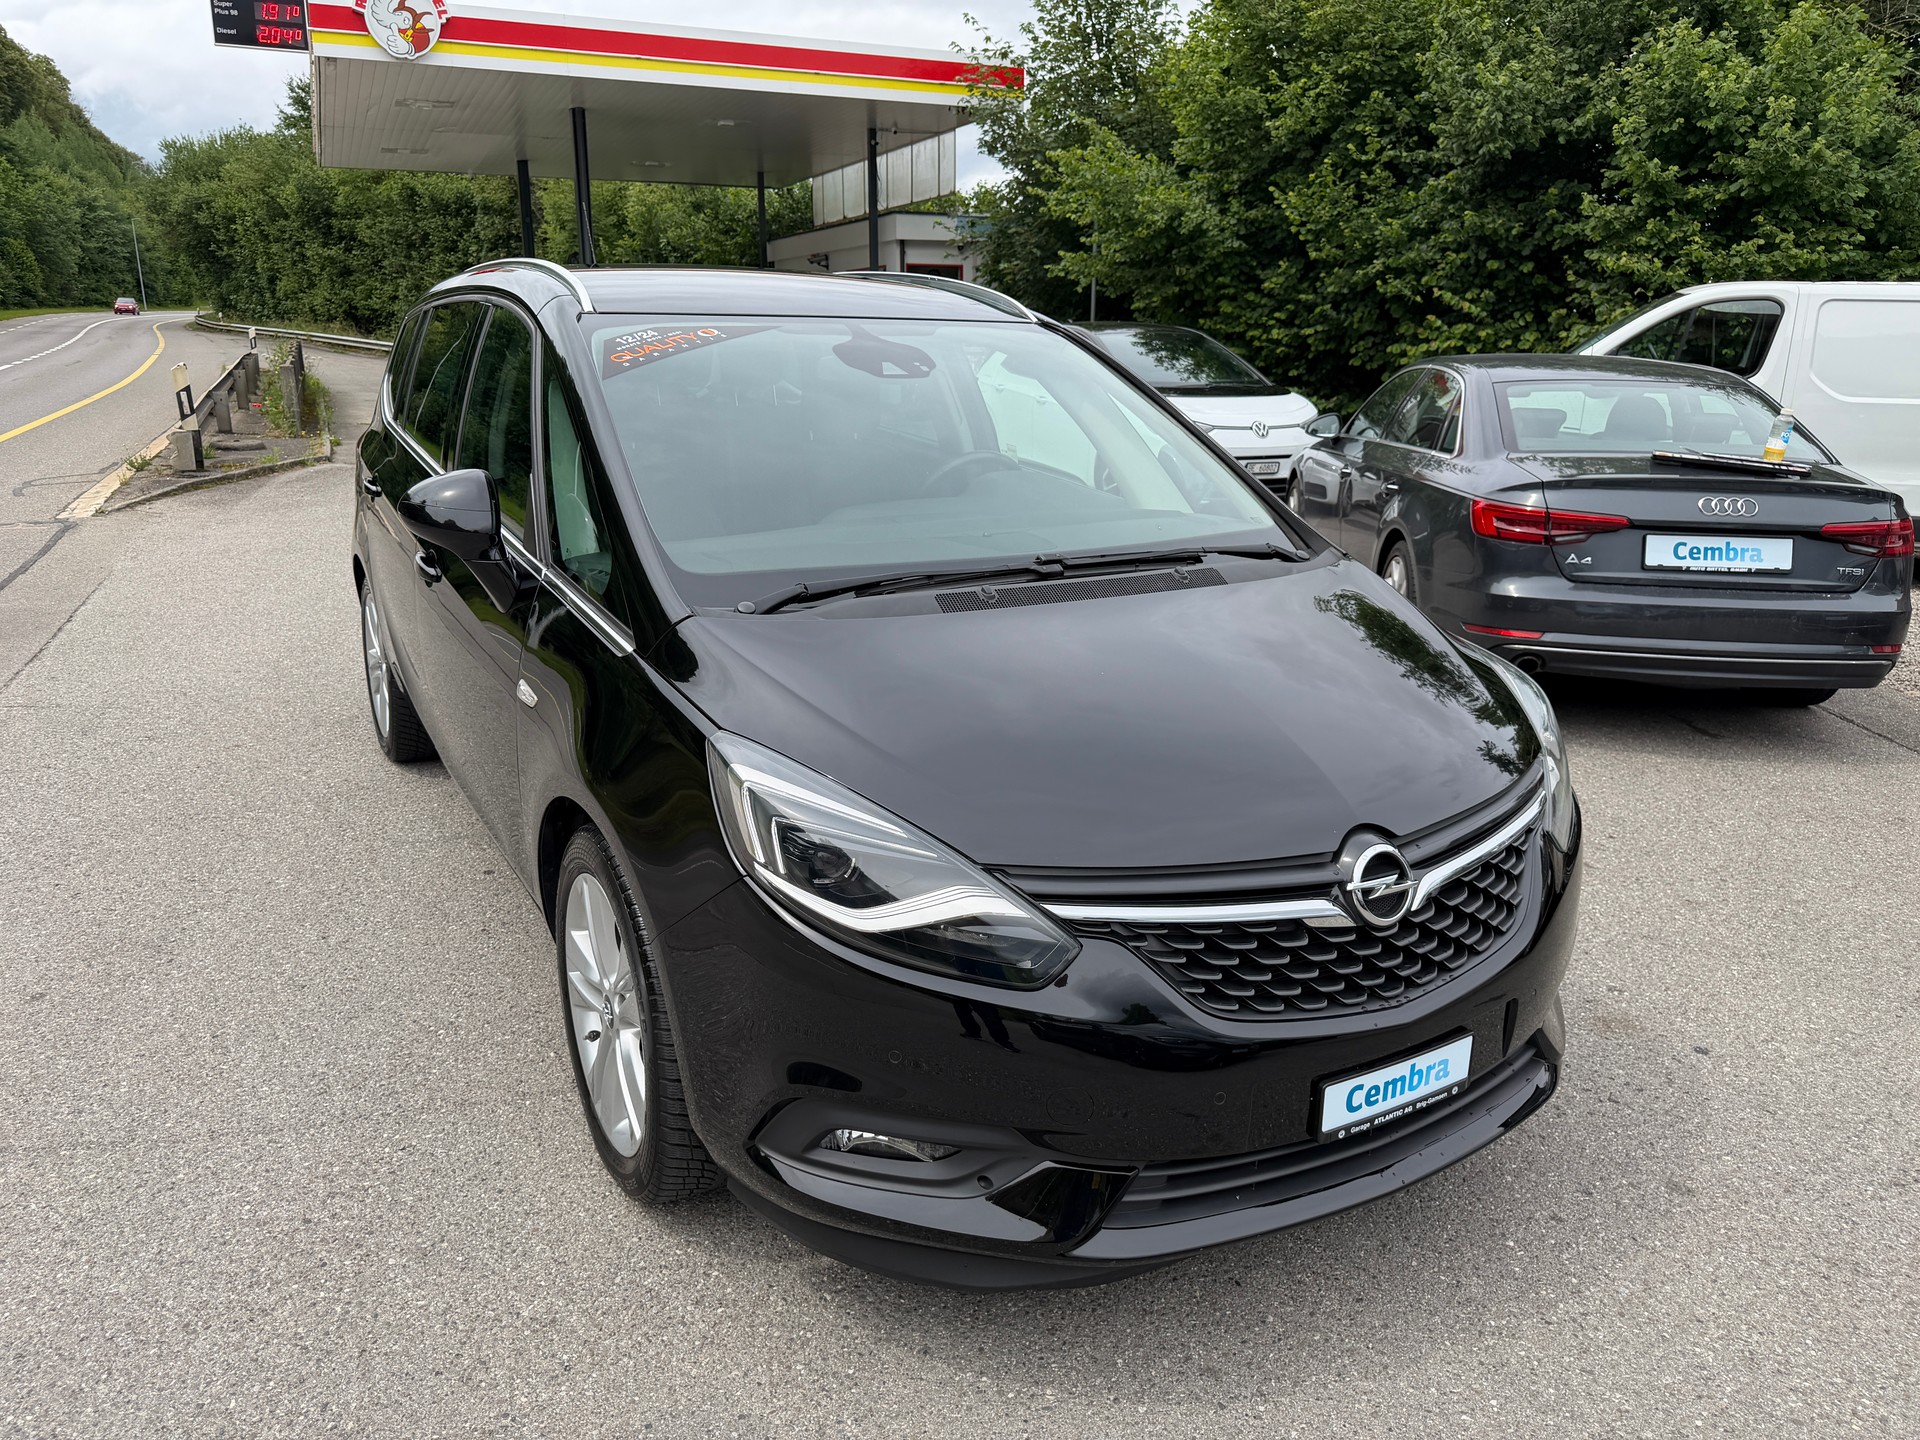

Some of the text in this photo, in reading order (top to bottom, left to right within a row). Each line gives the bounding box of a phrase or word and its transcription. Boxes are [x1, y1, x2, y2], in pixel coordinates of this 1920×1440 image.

[216, 27, 237, 35] Diesel
[615, 329, 659, 345] 12/24
[610, 332, 698, 362] QUALITY
[1564, 553, 1592, 565] A4
[1673, 541, 1764, 563] Cembra
[1836, 567, 1865, 576] TFSI
[1345, 1058, 1450, 1114] Cembra
[1350, 1092, 1448, 1134] Garage ATLANTIC AG Brig-Gamsen
